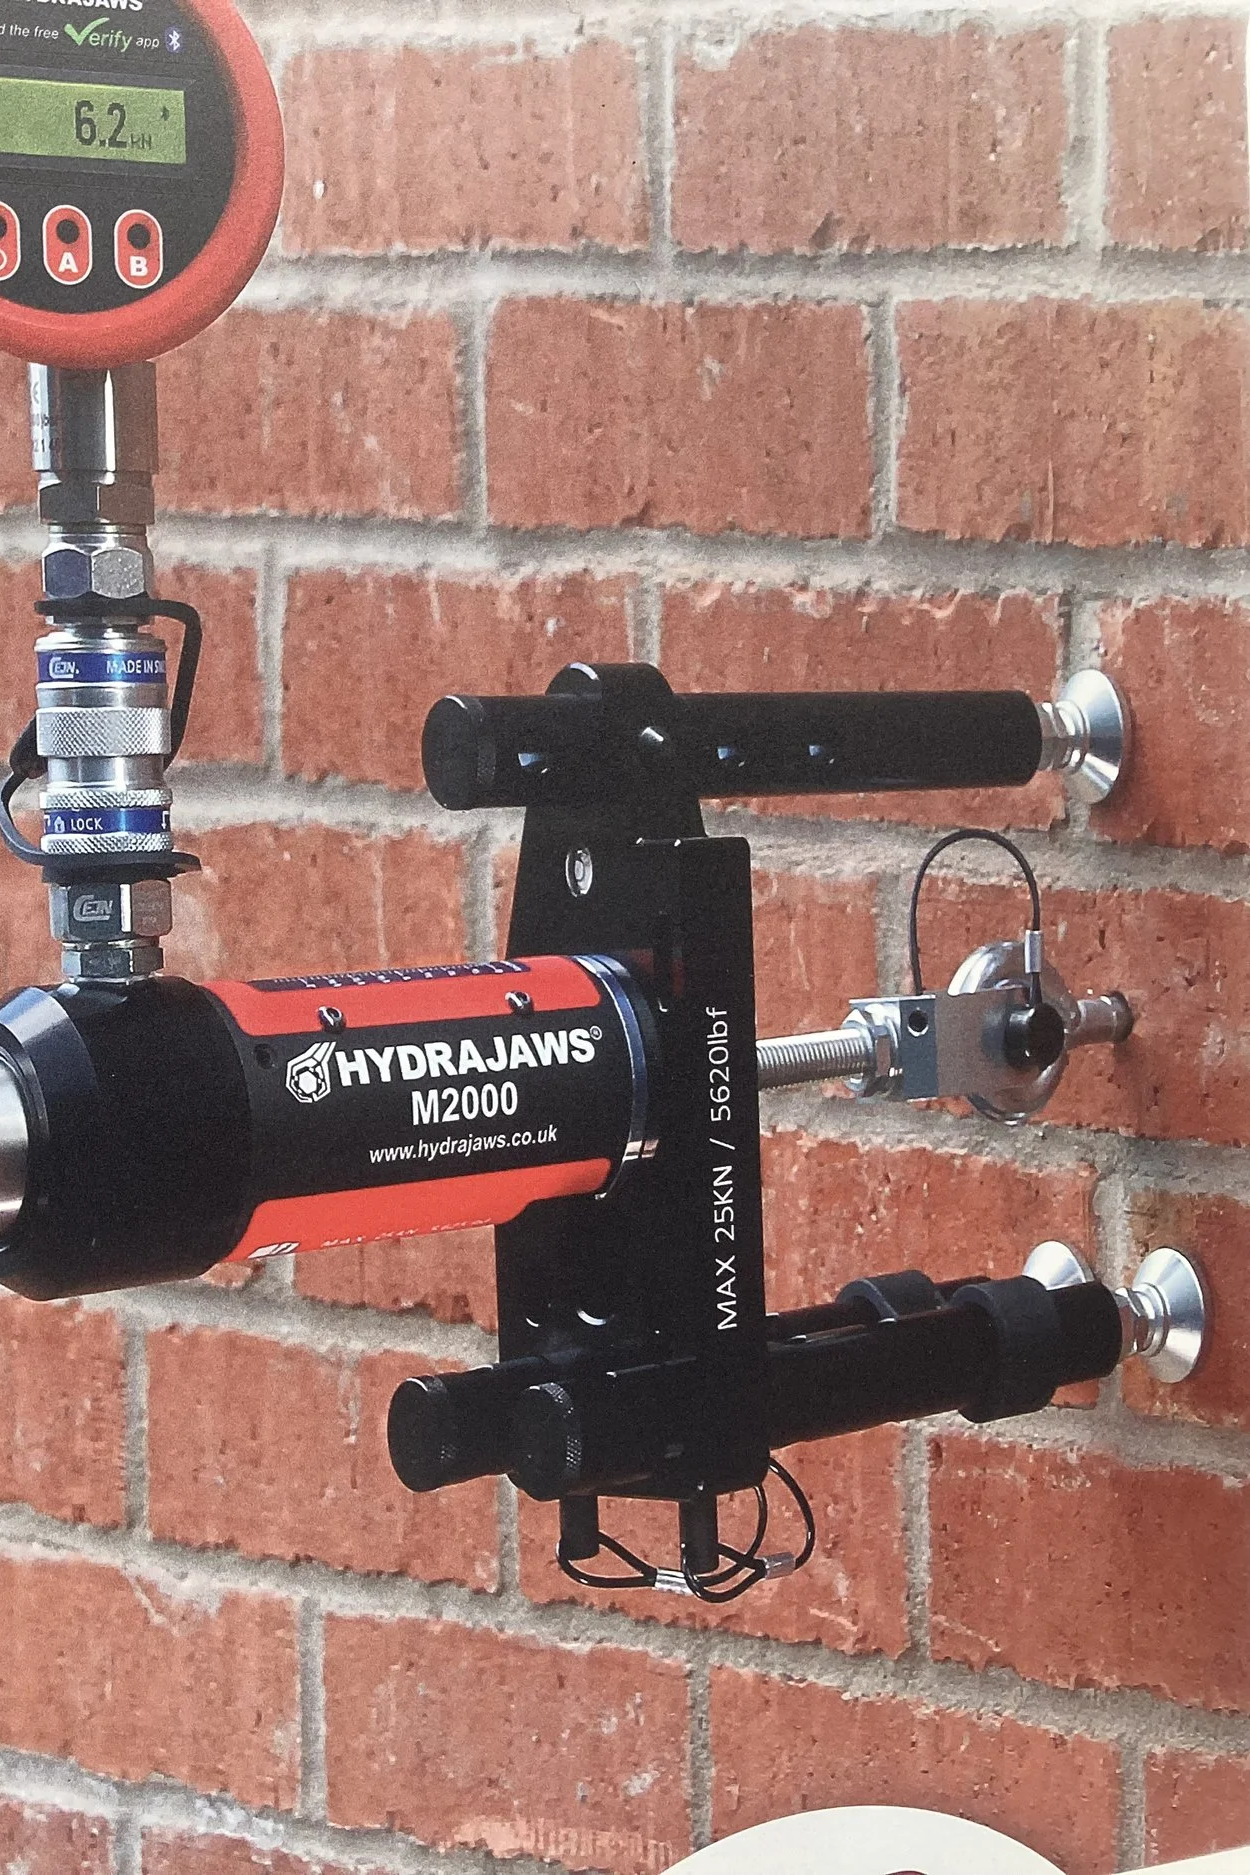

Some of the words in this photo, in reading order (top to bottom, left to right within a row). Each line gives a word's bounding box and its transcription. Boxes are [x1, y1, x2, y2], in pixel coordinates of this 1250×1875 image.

[9, 24, 30, 37] the
[34, 25, 59, 40] free
[135, 36, 160, 49] app
[74, 100, 128, 148] 6.2
[58, 252, 79, 273] A
[129, 256, 149, 277] B
[106, 659, 141, 675] MADE
[143, 660, 154, 674] IN
[70, 817, 104, 831] LOCK
[705, 1006, 731, 1122] 5620lbf
[411, 1081, 518, 1126] M2000
[369, 1124, 558, 1164] www.hydrajaws.co.uk
[709, 1137, 736, 1151] /
[712, 1165, 735, 1243] 25KN
[715, 1255, 738, 1330] MAX
